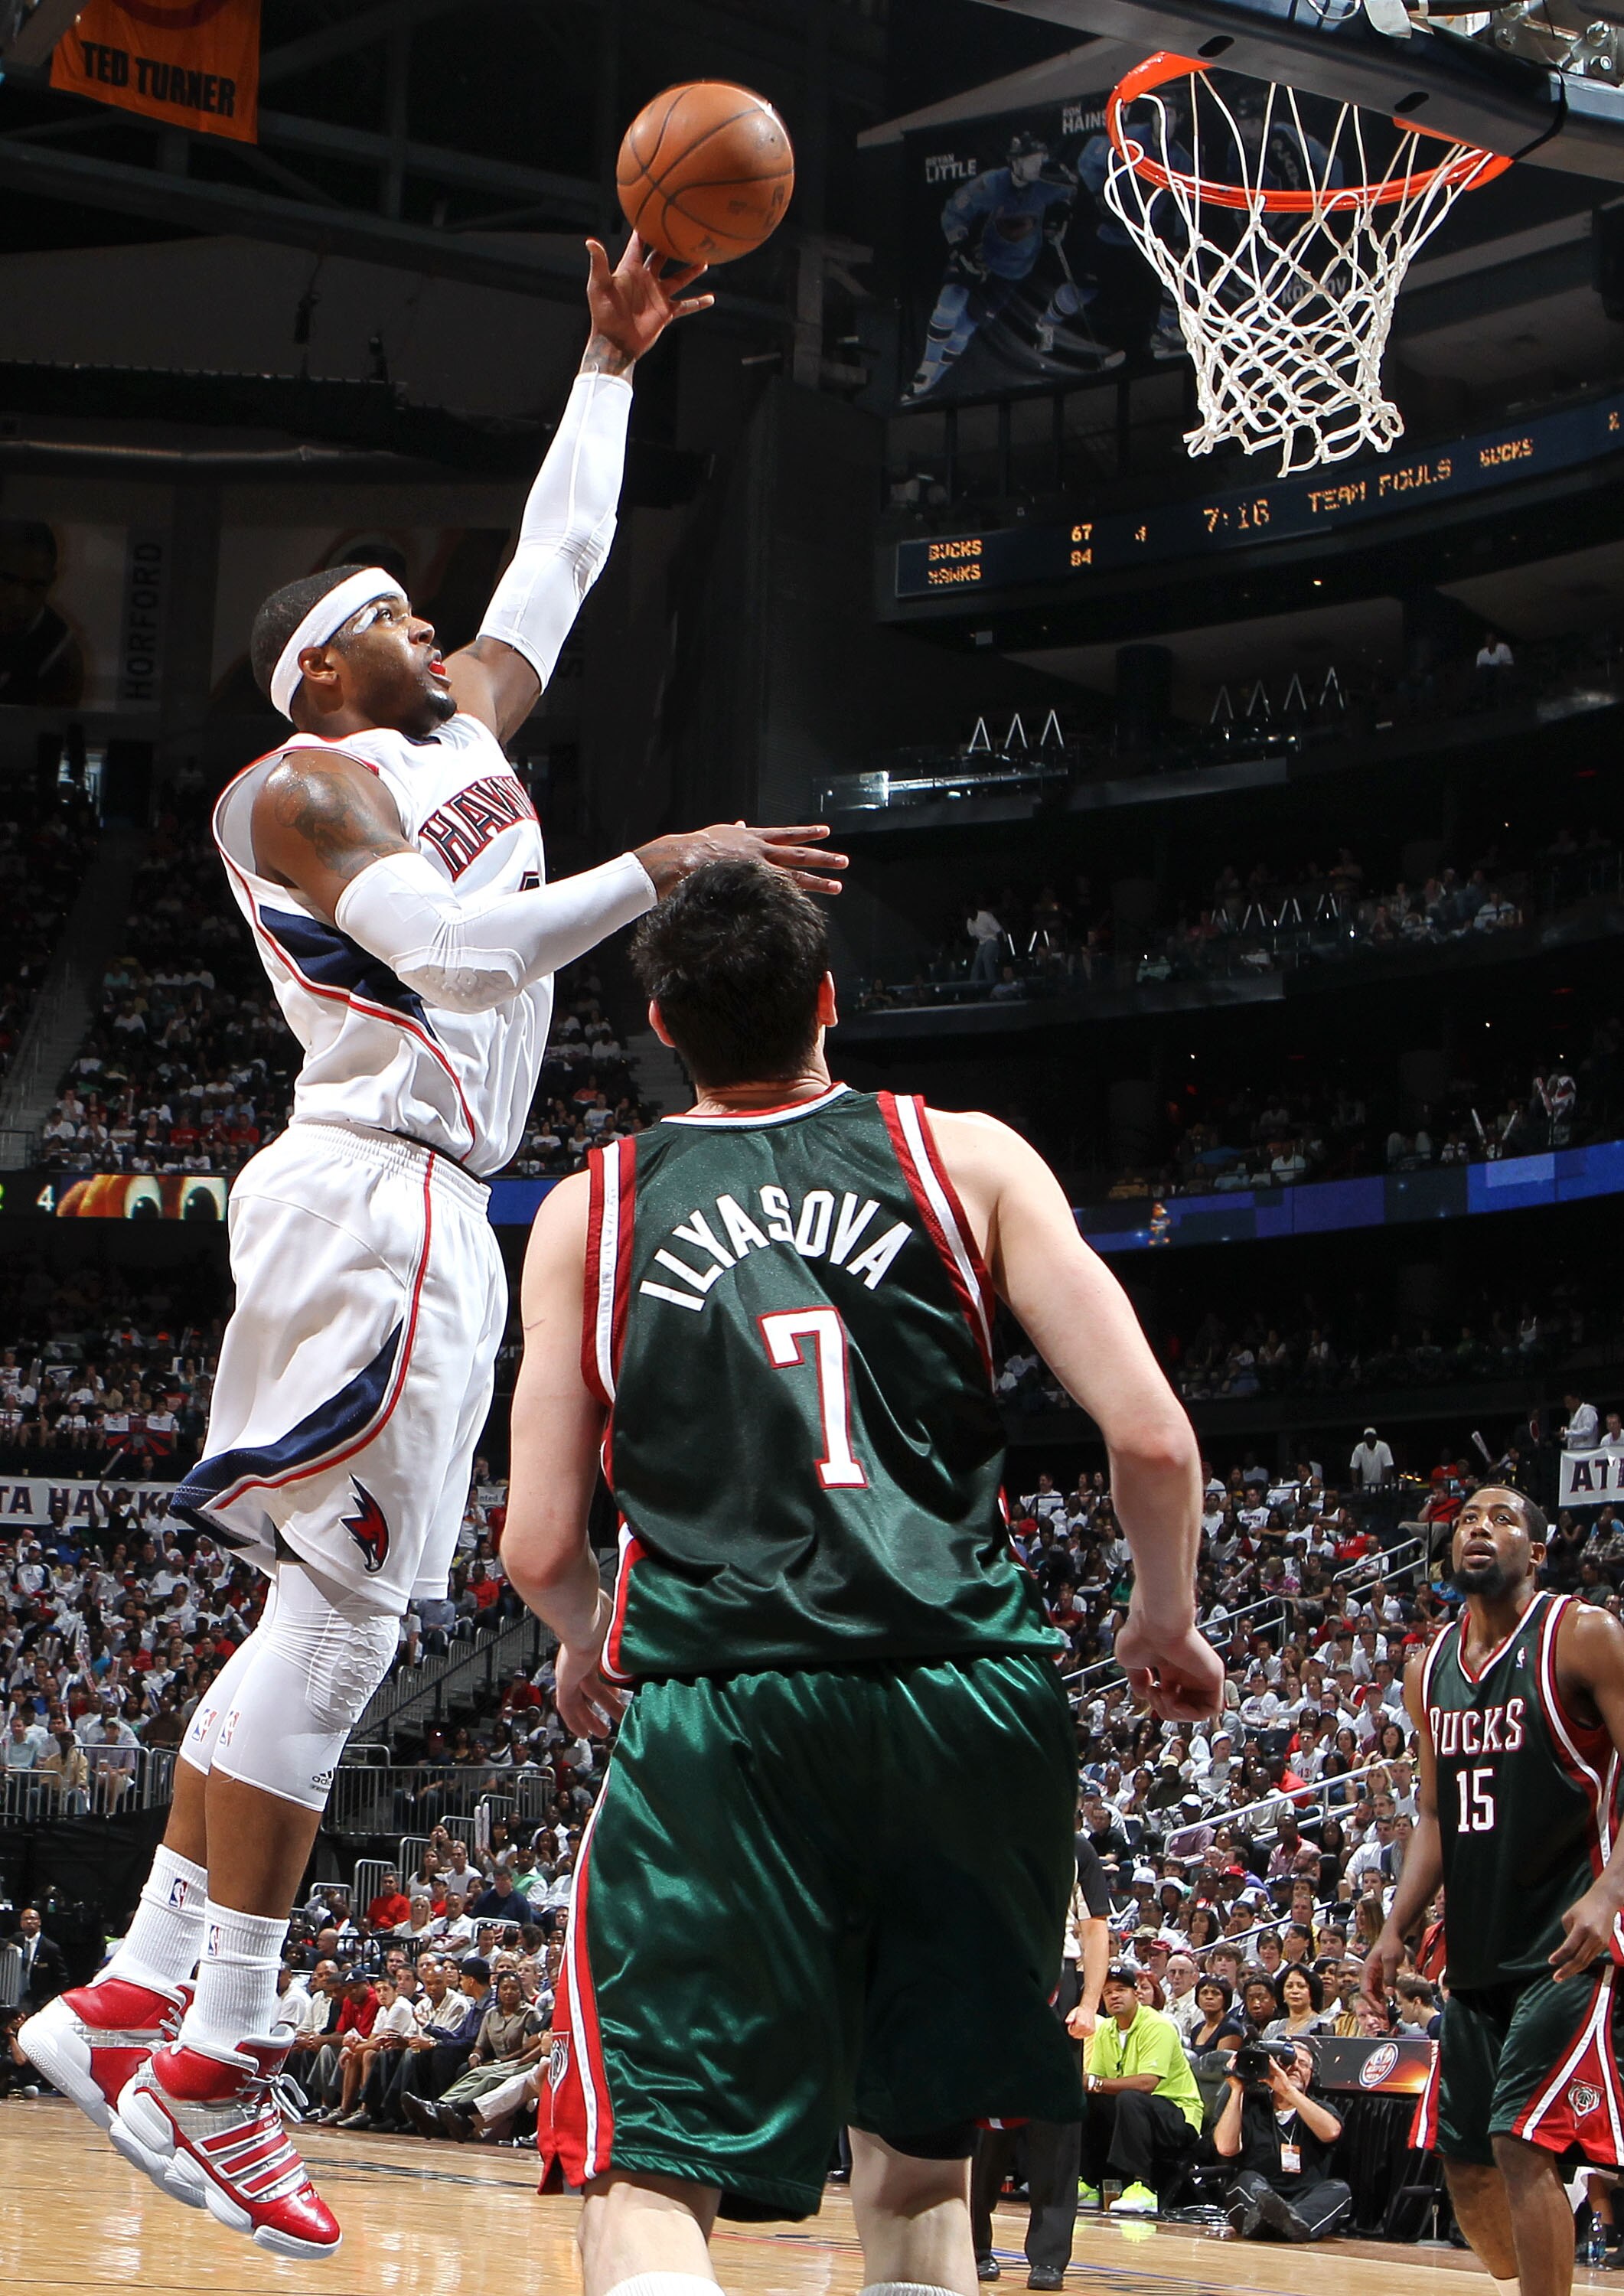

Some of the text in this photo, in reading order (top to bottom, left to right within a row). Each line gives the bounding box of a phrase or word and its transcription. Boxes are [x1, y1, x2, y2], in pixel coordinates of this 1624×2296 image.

[80, 41, 236, 118] TED TURNER
[926, 158, 977, 184] LITTLE
[1307, 458, 1452, 513] TEAM FOULS
[928, 523, 1094, 561] BUCKS 67
[1202, 499, 1270, 533] 7:16
[1071, 547, 1093, 567] 84
[125, 542, 162, 700] HORFORD
[37, 1185, 55, 1212] 4
[638, 1183, 914, 1313] ILYASOVA
[756, 1306, 869, 1490] 7
[1430, 1696, 1525, 1756] BUCKS
[1455, 1766, 1497, 1834] 15
